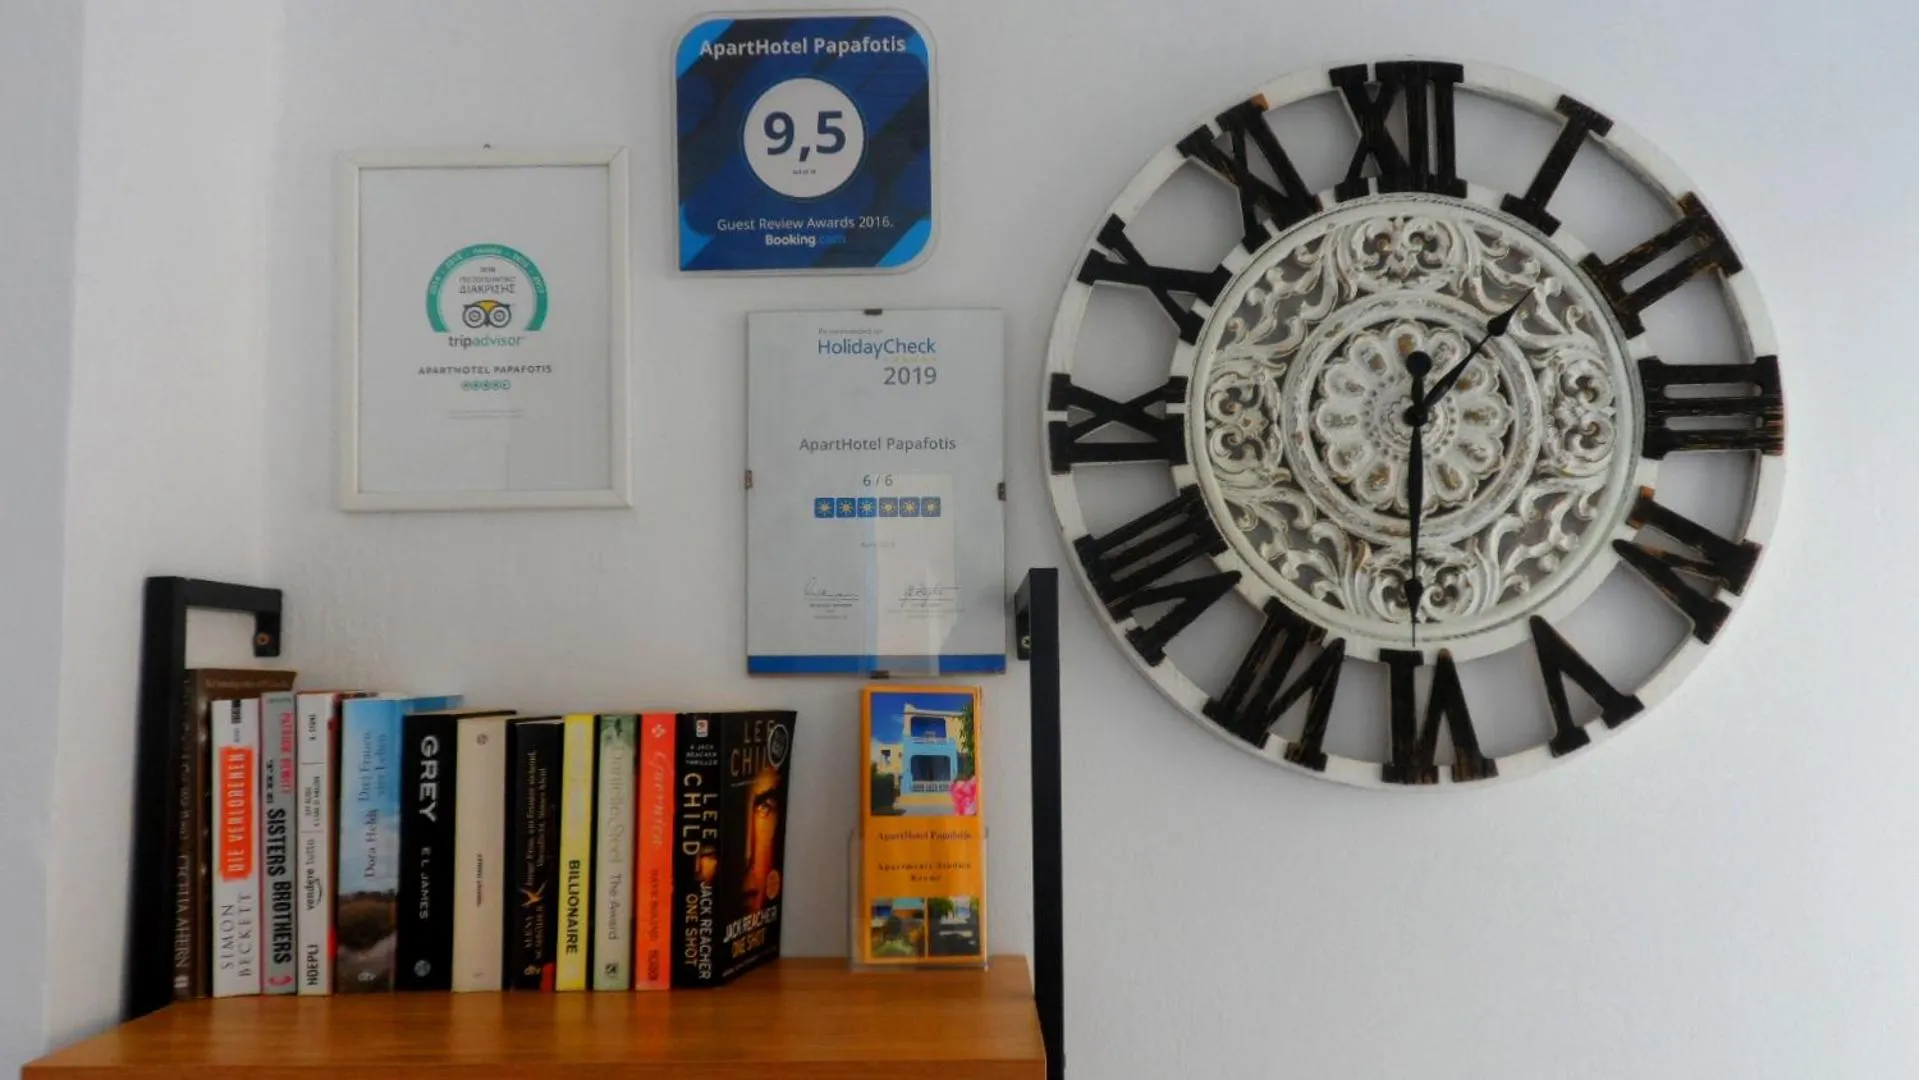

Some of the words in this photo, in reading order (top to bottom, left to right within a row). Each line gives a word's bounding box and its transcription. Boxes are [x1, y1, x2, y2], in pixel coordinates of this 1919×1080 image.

[699, 37, 808, 60] ApartHotel
[814, 35, 907, 56] Papafotis
[763, 110, 847, 162] 9,5
[1330, 61, 1467, 202] XII
[1177, 94, 1323, 253] XI
[717, 218, 755, 231] Guest
[759, 217, 803, 229] Review
[807, 217, 855, 228] Awards
[859, 216, 894, 228] 2016.
[1077, 214, 1234, 345] X
[1582, 193, 1743, 339] II
[448, 335, 522, 349] tripadvisor
[818, 337, 937, 360] HolidayCheck
[418, 366, 490, 375] APARTHOTEL
[494, 365, 552, 374] PAPAFOTIS
[883, 365, 937, 385] 2019
[1049, 372, 1187, 473] IX
[1639, 354, 1784, 460] III
[799, 437, 881, 452] ApartHotel
[886, 436, 957, 453] Papafotis
[863, 474, 871, 487] 6
[885, 474, 894, 487] 6
[1074, 485, 1242, 666] VIII
[1613, 486, 1763, 644] IV
[1203, 598, 1346, 771] VII
[1530, 616, 1645, 757] V
[1380, 648, 1498, 785] VI
[419, 735, 440, 822] GREY
[683, 772, 702, 856] CHILD
[702, 792, 718, 839] LEE
[267, 808, 286, 876] SISTERS
[305, 838, 315, 867] tutto
[364, 847, 376, 878] Dora
[306, 869, 315, 911] vendere
[419, 873, 429, 920] JAMES
[566, 860, 580, 954] BILLIONAIRE
[609, 873, 622, 896] The
[685, 893, 698, 923] ONE
[700, 881, 712, 915] JACK
[220, 904, 234, 969] SIMON
[238, 893, 251, 977] BECKETT
[272, 881, 292, 965] BROTHERS
[608, 900, 621, 941] Award
[723, 918, 744, 944] JACK
[307, 944, 319, 986] HOEPLI
[684, 926, 698, 967] SHOT
[698, 918, 713, 981] REACHER
